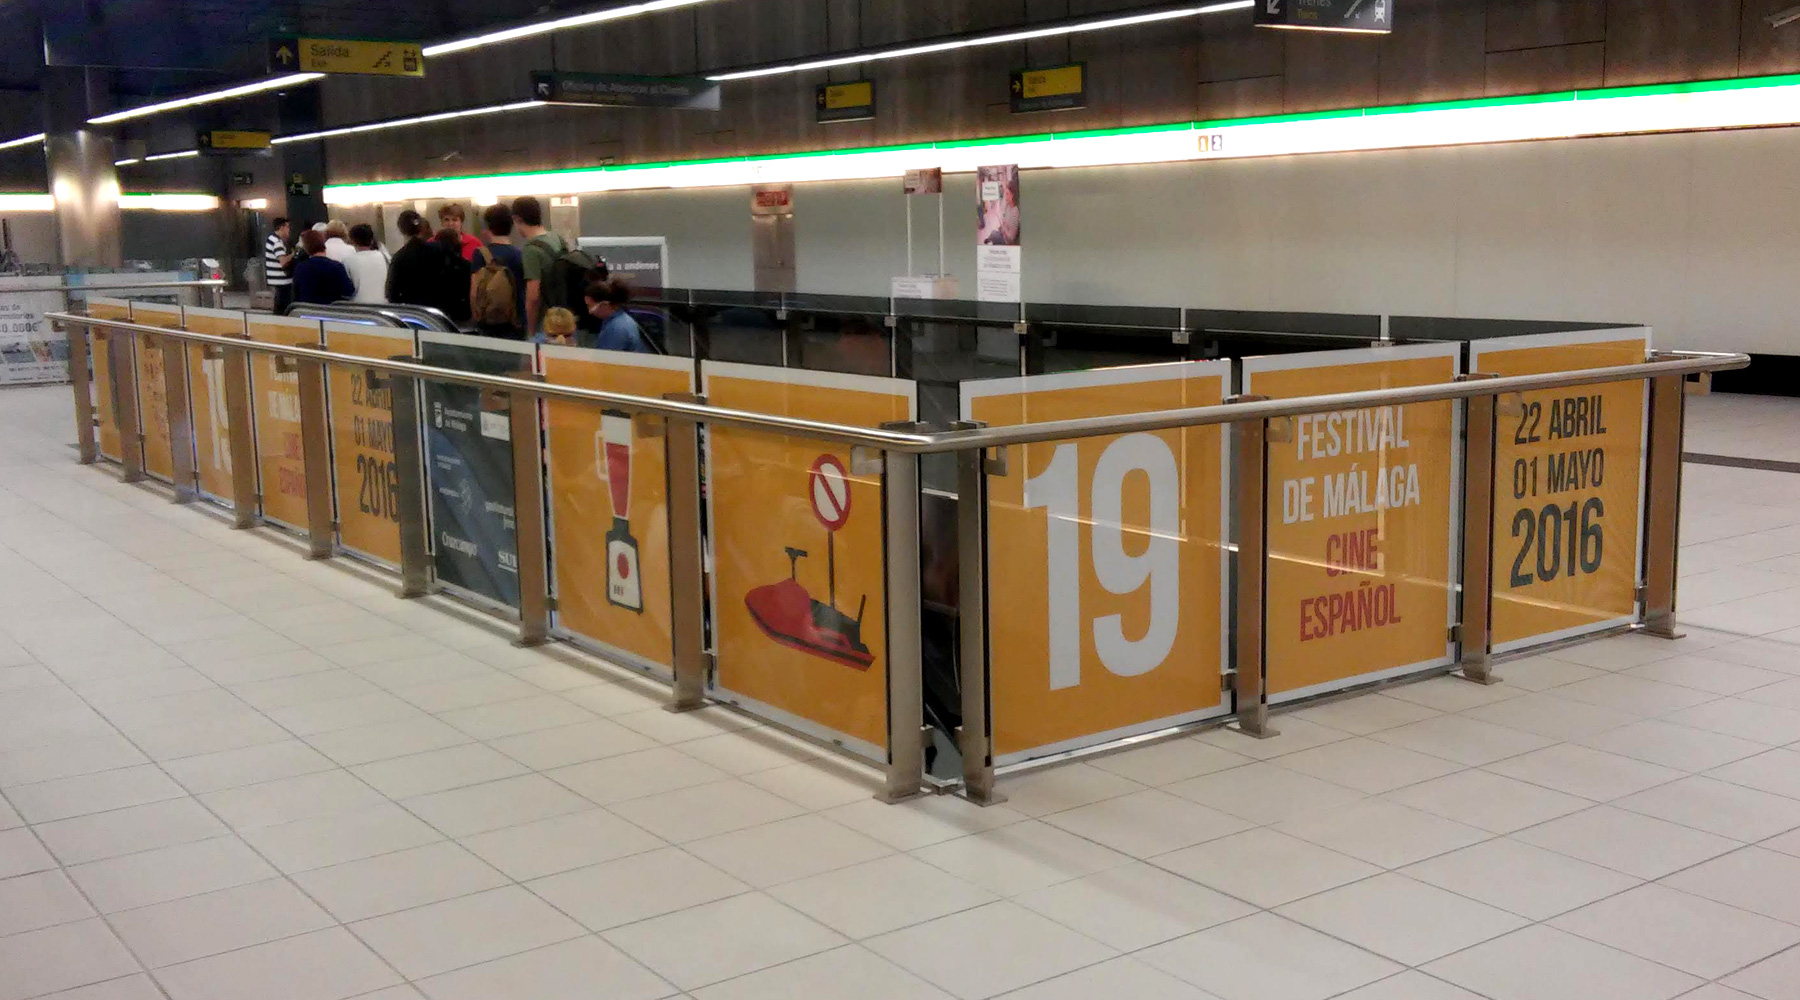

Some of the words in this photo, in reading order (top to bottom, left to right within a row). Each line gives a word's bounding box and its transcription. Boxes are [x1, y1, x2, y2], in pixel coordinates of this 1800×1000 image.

[310, 43, 350, 58] Salida
[1298, 405, 1410, 461] FESTIVAL
[1515, 401, 1541, 445] 22
[1548, 395, 1606, 440] ABRIL
[1283, 476, 1315, 525] DE
[1323, 462, 1420, 518] MÁLAGA
[1514, 456, 1538, 500] 01
[1547, 448, 1605, 495] MAYO
[1023, 433, 1179, 691] 19
[1326, 528, 1378, 577] CINE
[1511, 497, 1605, 588] 2016
[1300, 580, 1401, 642] ESPAÑOL
